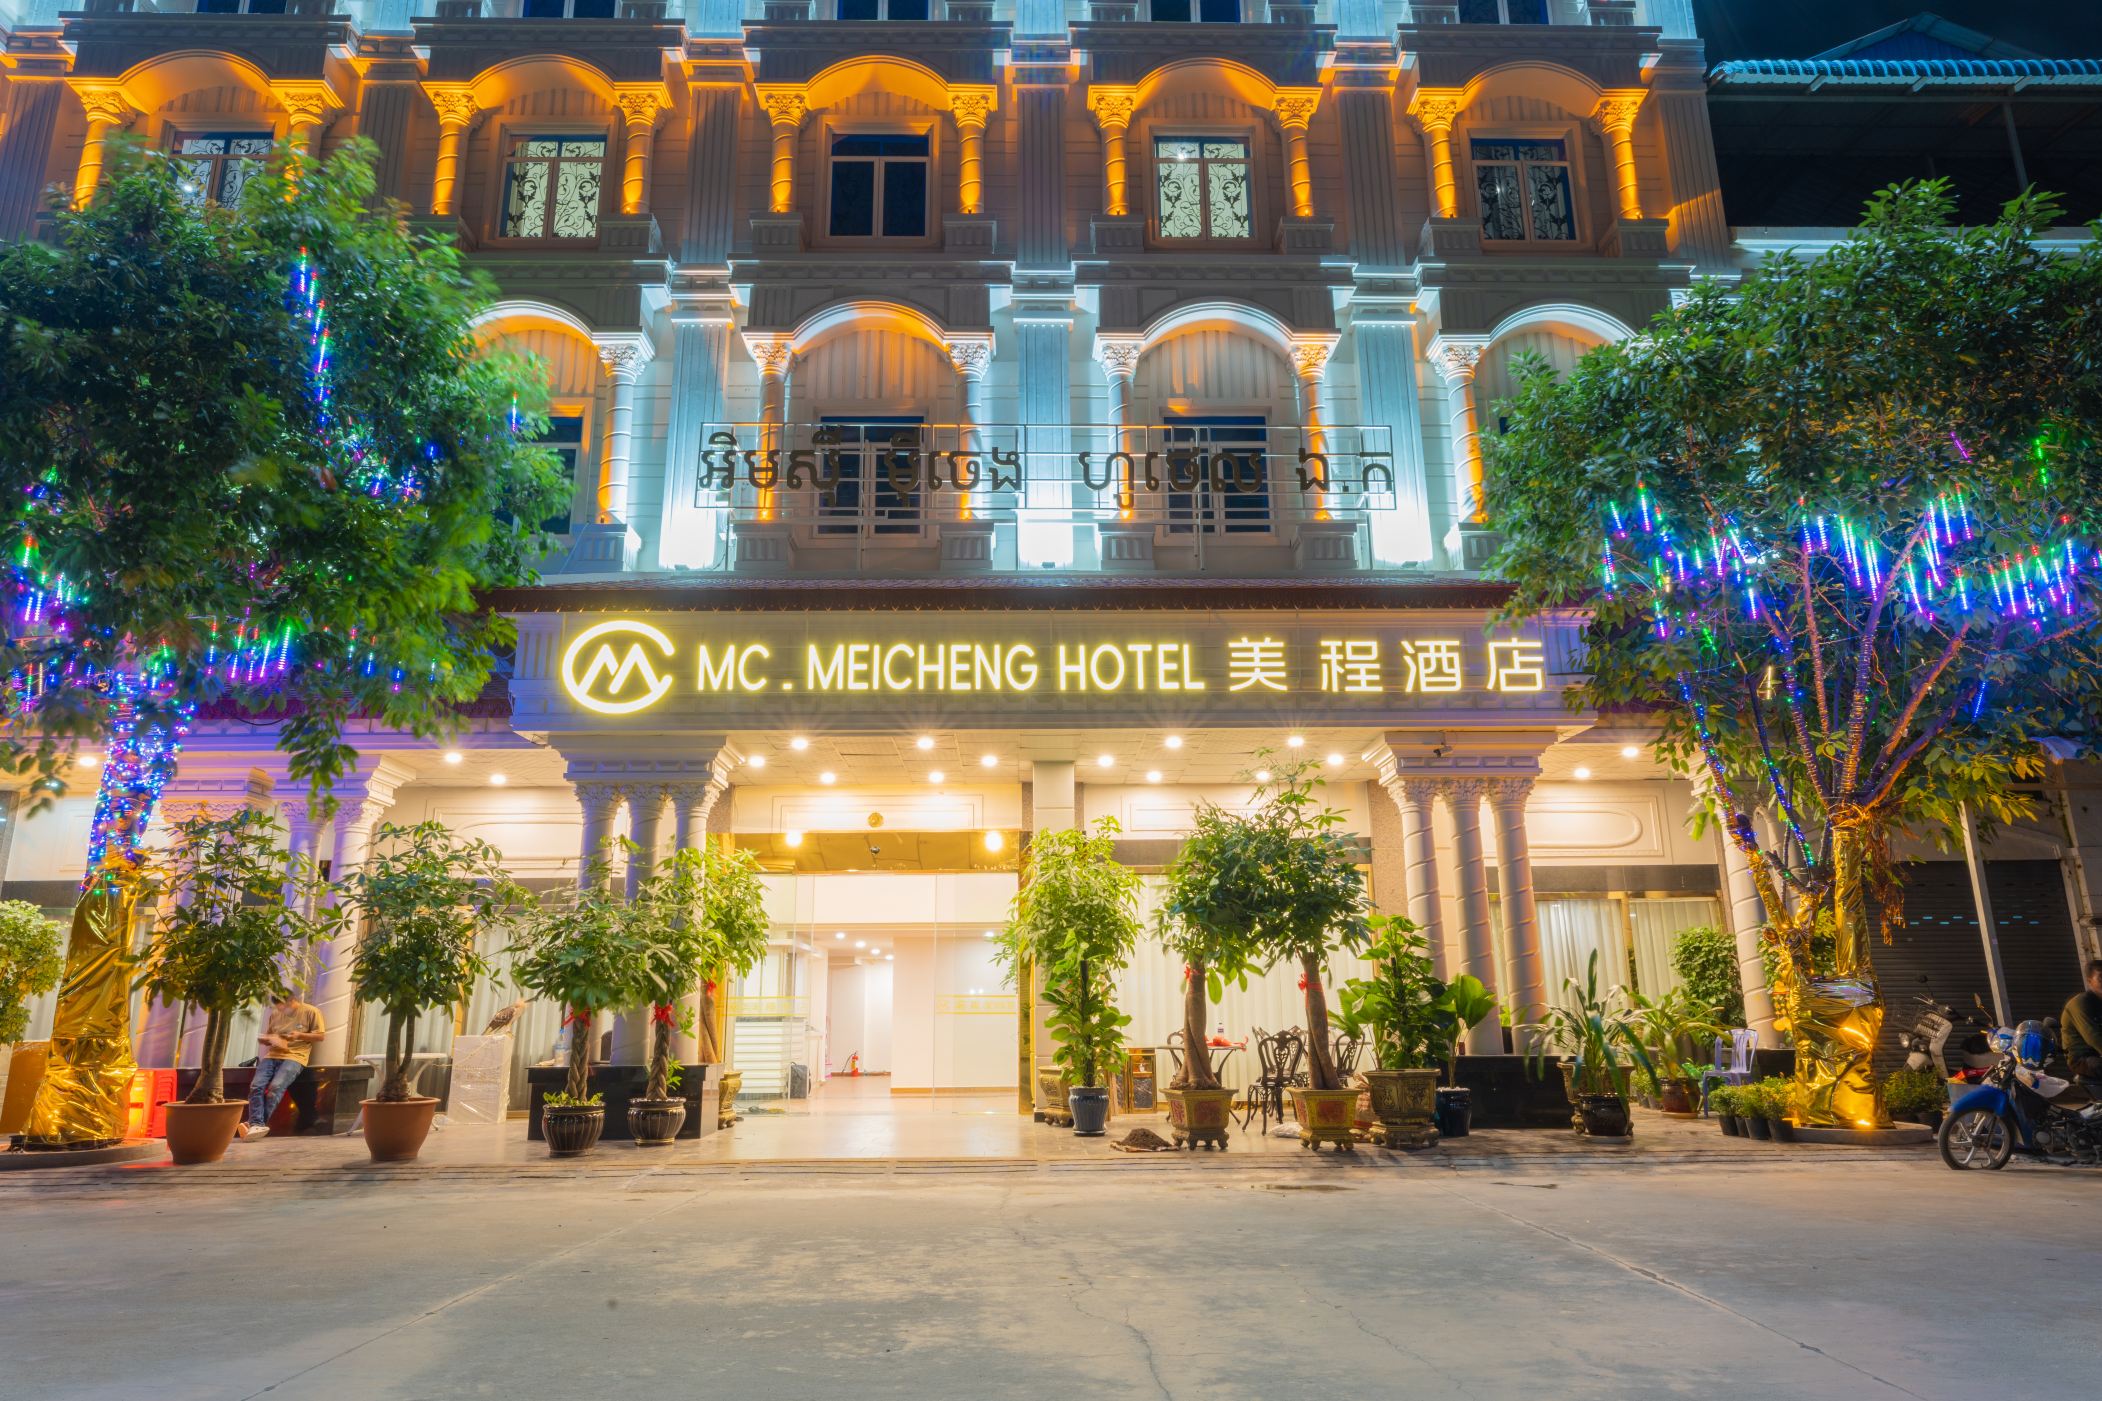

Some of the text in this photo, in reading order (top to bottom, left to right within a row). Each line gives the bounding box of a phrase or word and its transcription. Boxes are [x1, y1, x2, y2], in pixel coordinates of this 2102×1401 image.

[807, 643, 1038, 691] MEICHENG
[1058, 643, 1205, 691] HOTEL
[1228, 636, 1545, 692] 美程酒店
